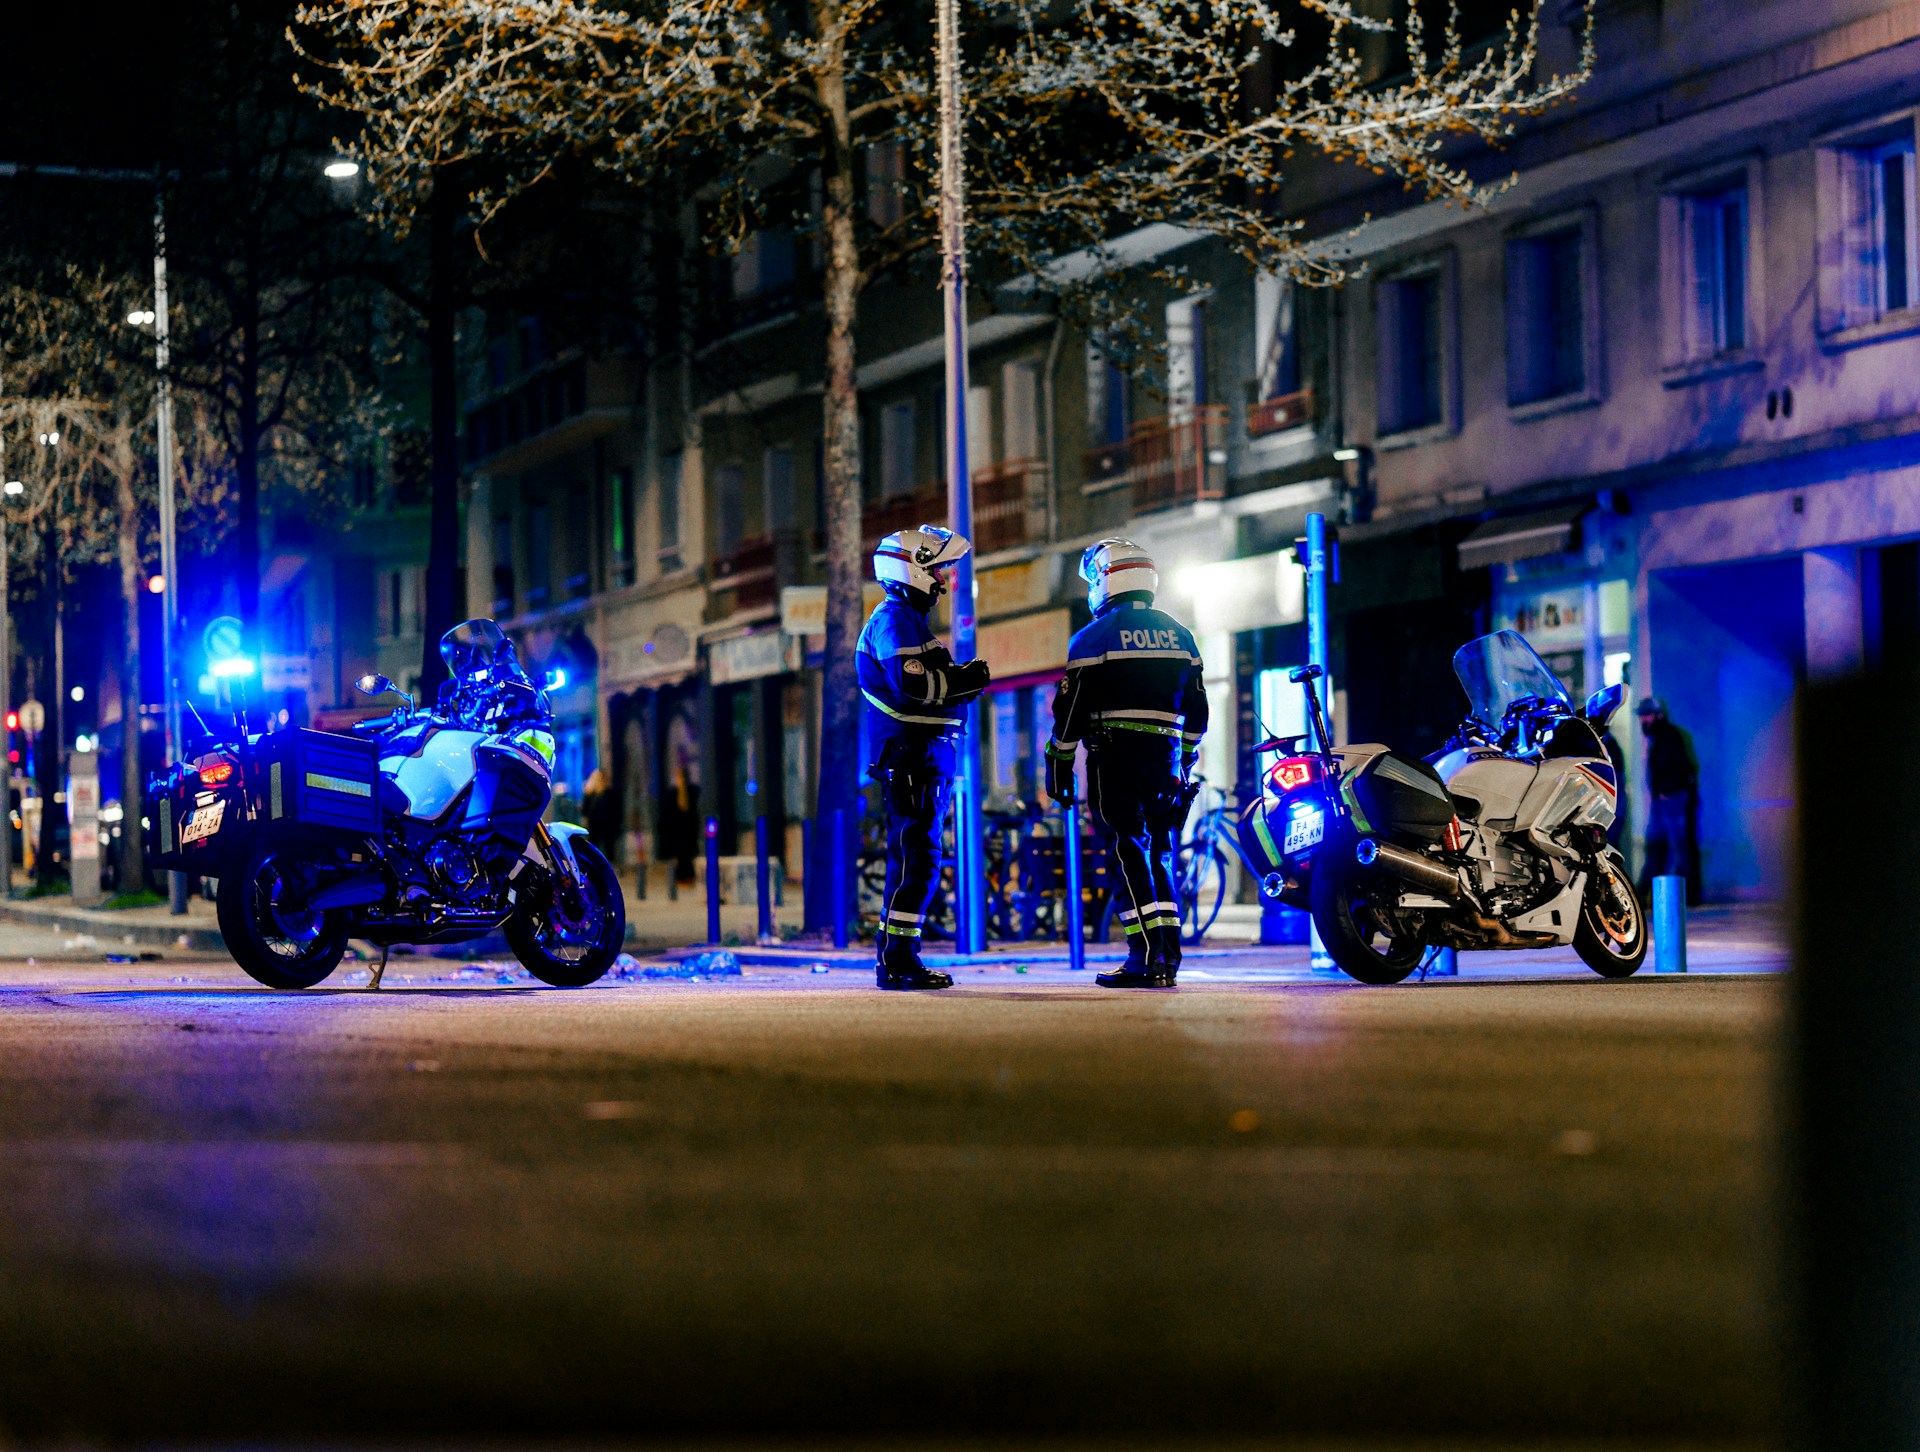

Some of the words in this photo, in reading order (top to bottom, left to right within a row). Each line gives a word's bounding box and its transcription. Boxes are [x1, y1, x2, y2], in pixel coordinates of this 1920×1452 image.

[1120, 629, 1180, 649] POLICE
[187, 817, 219, 836] 014-ZA
[1287, 826, 1323, 847] 495-KN
